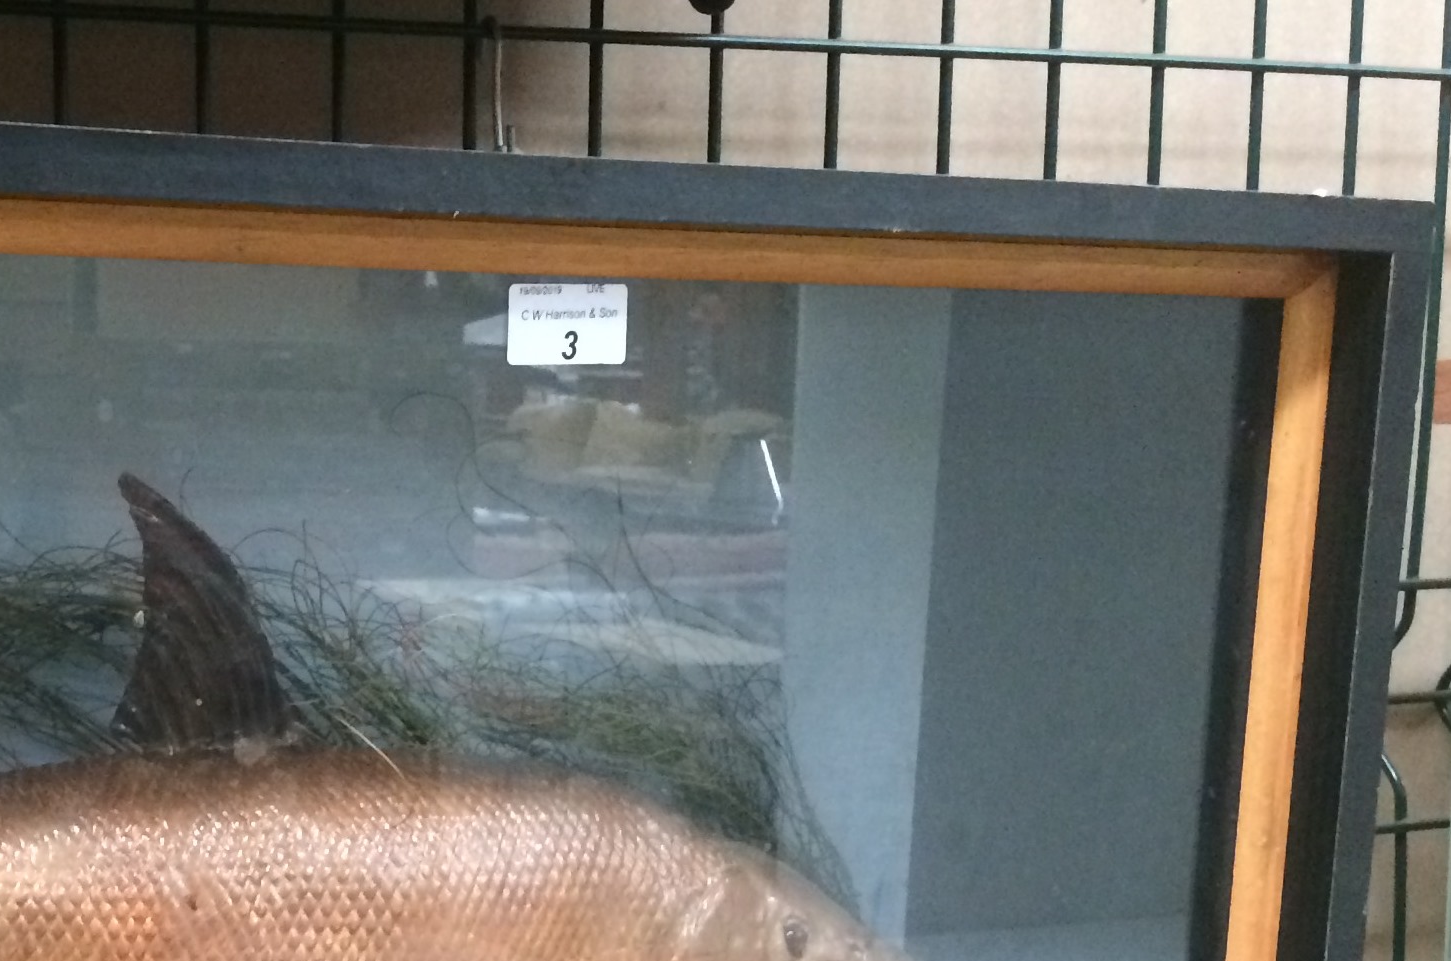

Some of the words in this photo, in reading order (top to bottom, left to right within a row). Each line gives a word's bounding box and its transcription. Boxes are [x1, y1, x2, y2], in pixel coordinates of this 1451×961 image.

[521, 309, 529, 320] C
[532, 310, 543, 320] W
[545, 308, 586, 320] Harrison
[588, 307, 596, 319] &
[599, 307, 618, 318] Son
[561, 330, 579, 361] 3
